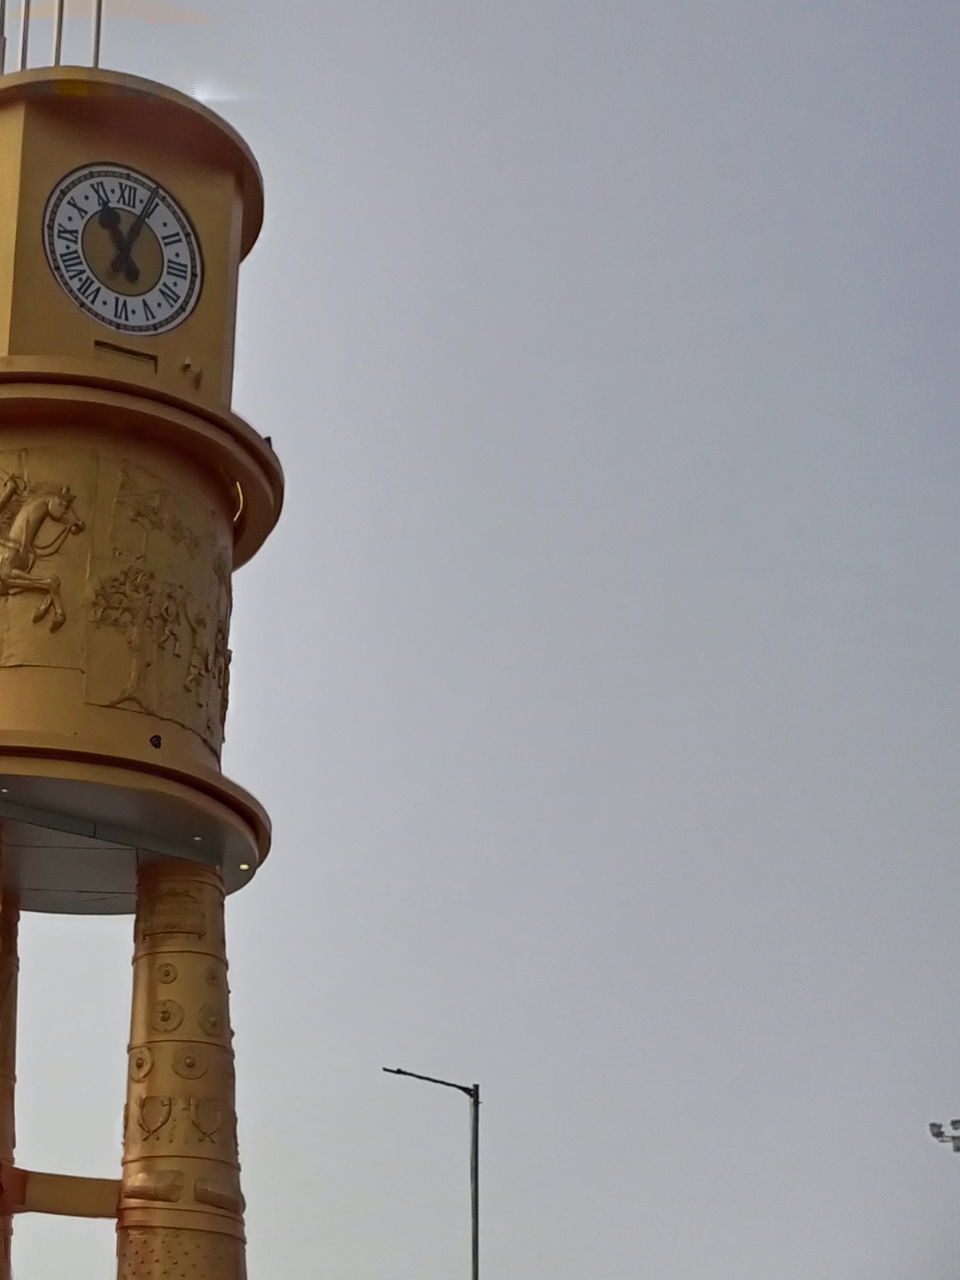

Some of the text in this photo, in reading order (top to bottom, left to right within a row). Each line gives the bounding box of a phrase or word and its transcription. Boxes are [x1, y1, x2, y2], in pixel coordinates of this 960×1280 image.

[117, 182, 137, 208] XII
[66, 197, 88, 219] X
[56, 222, 79, 245] IX
[161, 231, 183, 247] II
[59, 249, 86, 280] VIII
[167, 259, 188, 280] III
[77, 276, 102, 306] VII
[158, 282, 181, 308] IV
[113, 296, 130, 322] VI
[142, 298, 156, 321] V
